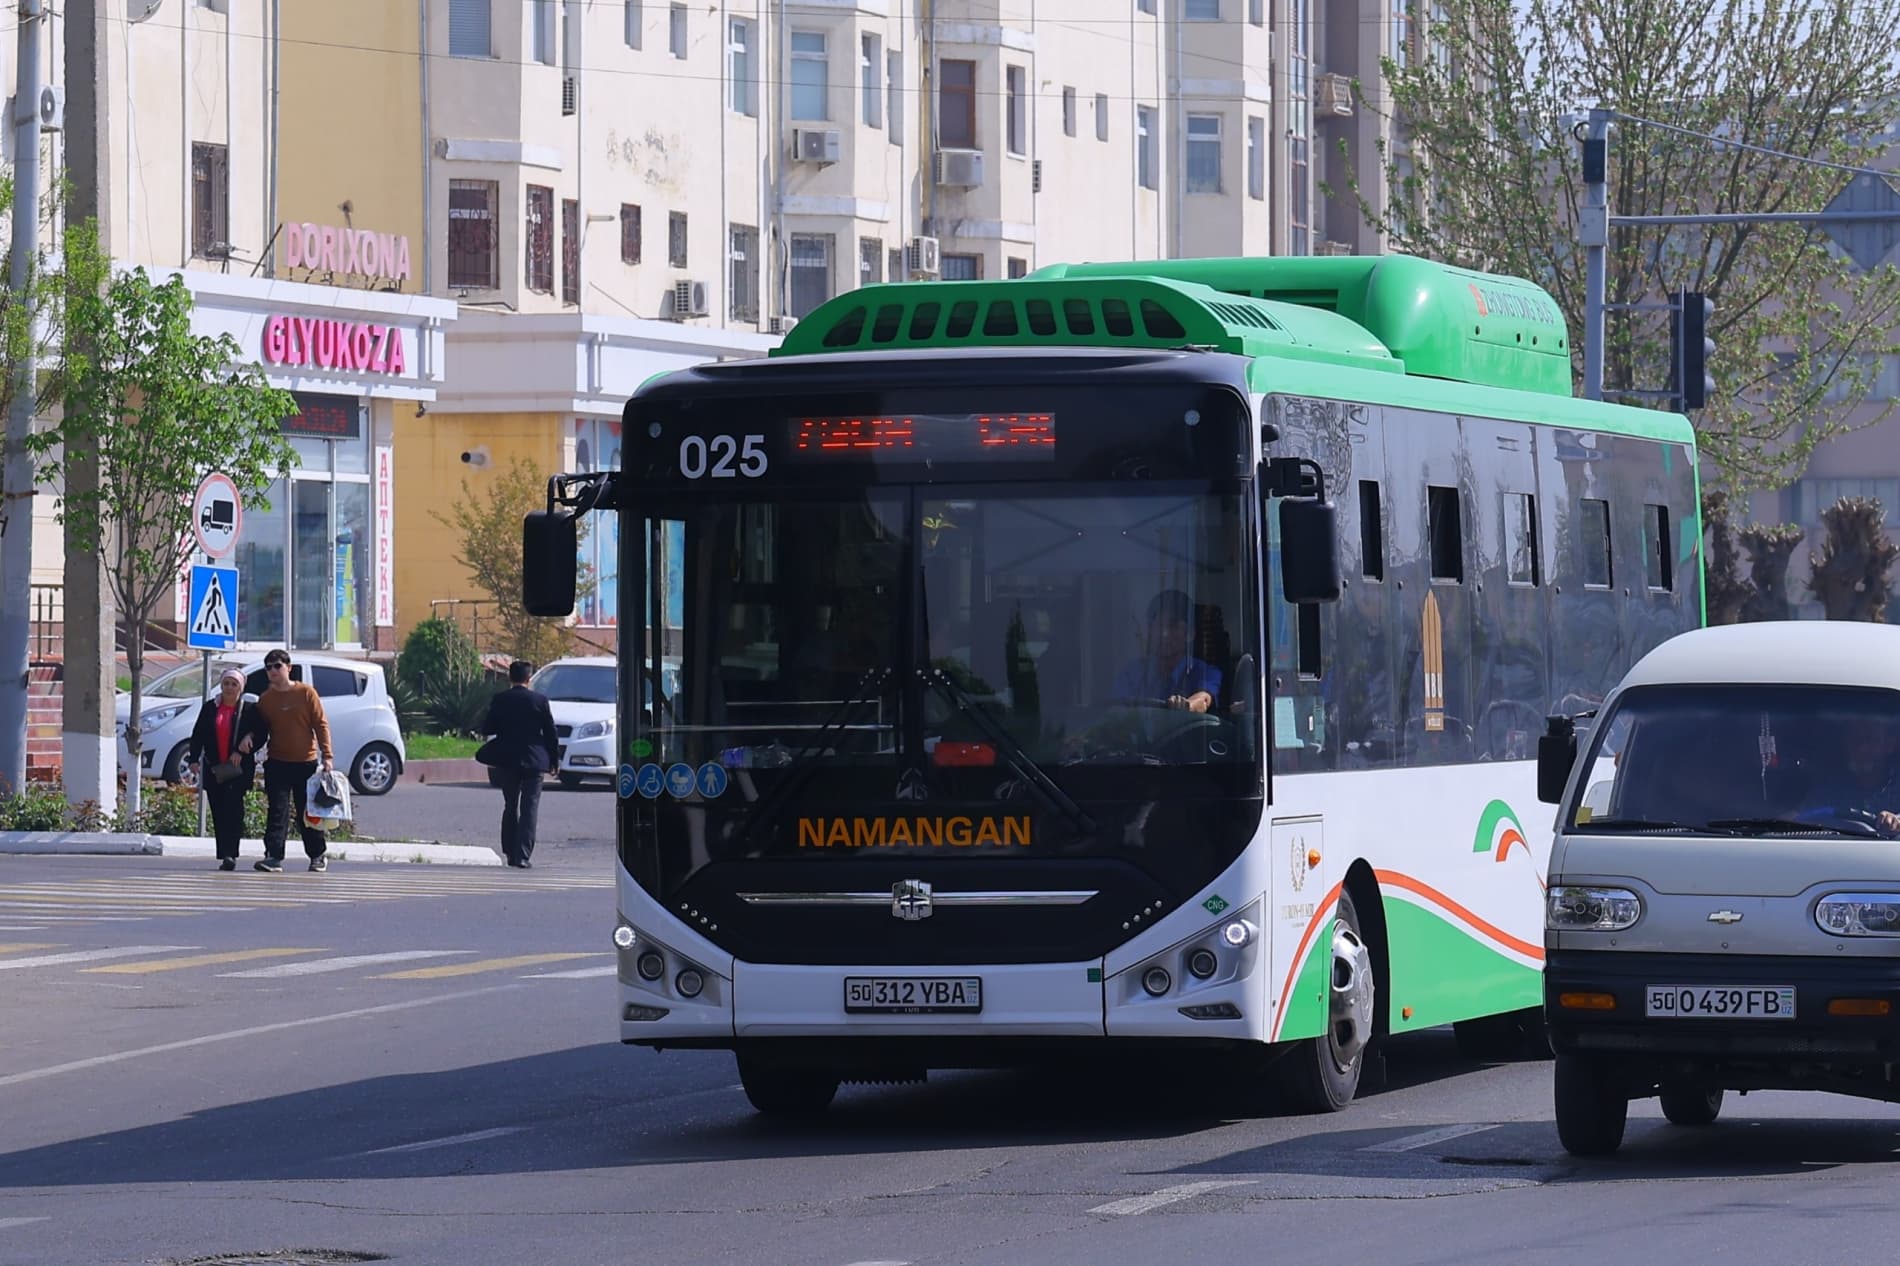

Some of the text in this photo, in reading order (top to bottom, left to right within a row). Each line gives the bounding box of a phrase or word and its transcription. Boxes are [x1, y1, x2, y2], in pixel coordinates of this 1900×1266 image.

[286, 222, 412, 280] DORIXONA
[265, 314, 406, 374] GLYUKOZA
[679, 434, 768, 479] 025
[379, 453, 389, 620] АПТЕКА
[799, 816, 1031, 847] NAMANGAN
[1207, 900, 1224, 910] CNG
[851, 984, 871, 1001] 50
[1652, 992, 1675, 1010] 50
